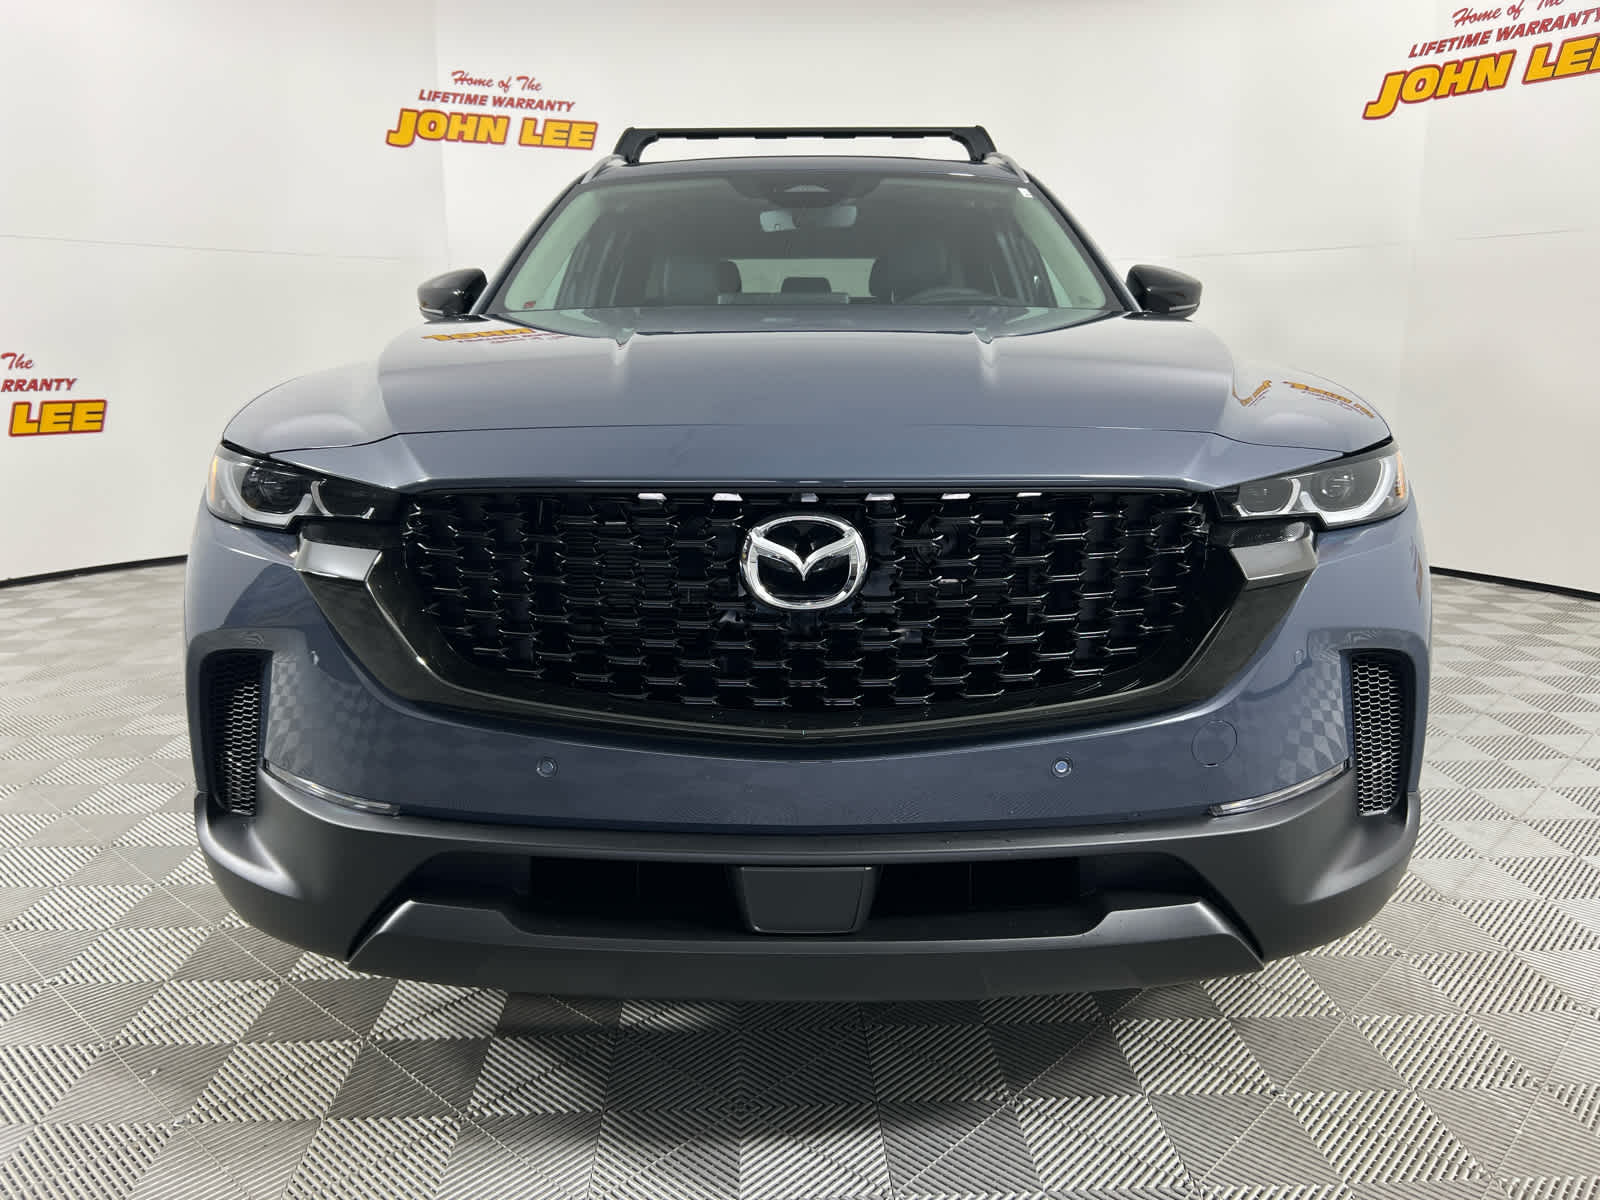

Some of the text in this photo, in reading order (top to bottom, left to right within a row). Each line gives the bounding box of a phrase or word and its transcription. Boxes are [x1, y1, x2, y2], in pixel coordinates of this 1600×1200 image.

[1452, 7, 1503, 28] Home
[1506, 0, 1525, 21] of
[1408, 30, 1493, 59] LIFETIME
[451, 70, 543, 93] Home of The
[1362, 49, 1518, 120] JOHN
[418, 88, 576, 112] LIFETIME WARRANTY
[385, 107, 599, 151] JOHN LEE
[0, 351, 34, 371] The
[0, 377, 78, 393] RRANTY
[8, 398, 108, 438] LEE
